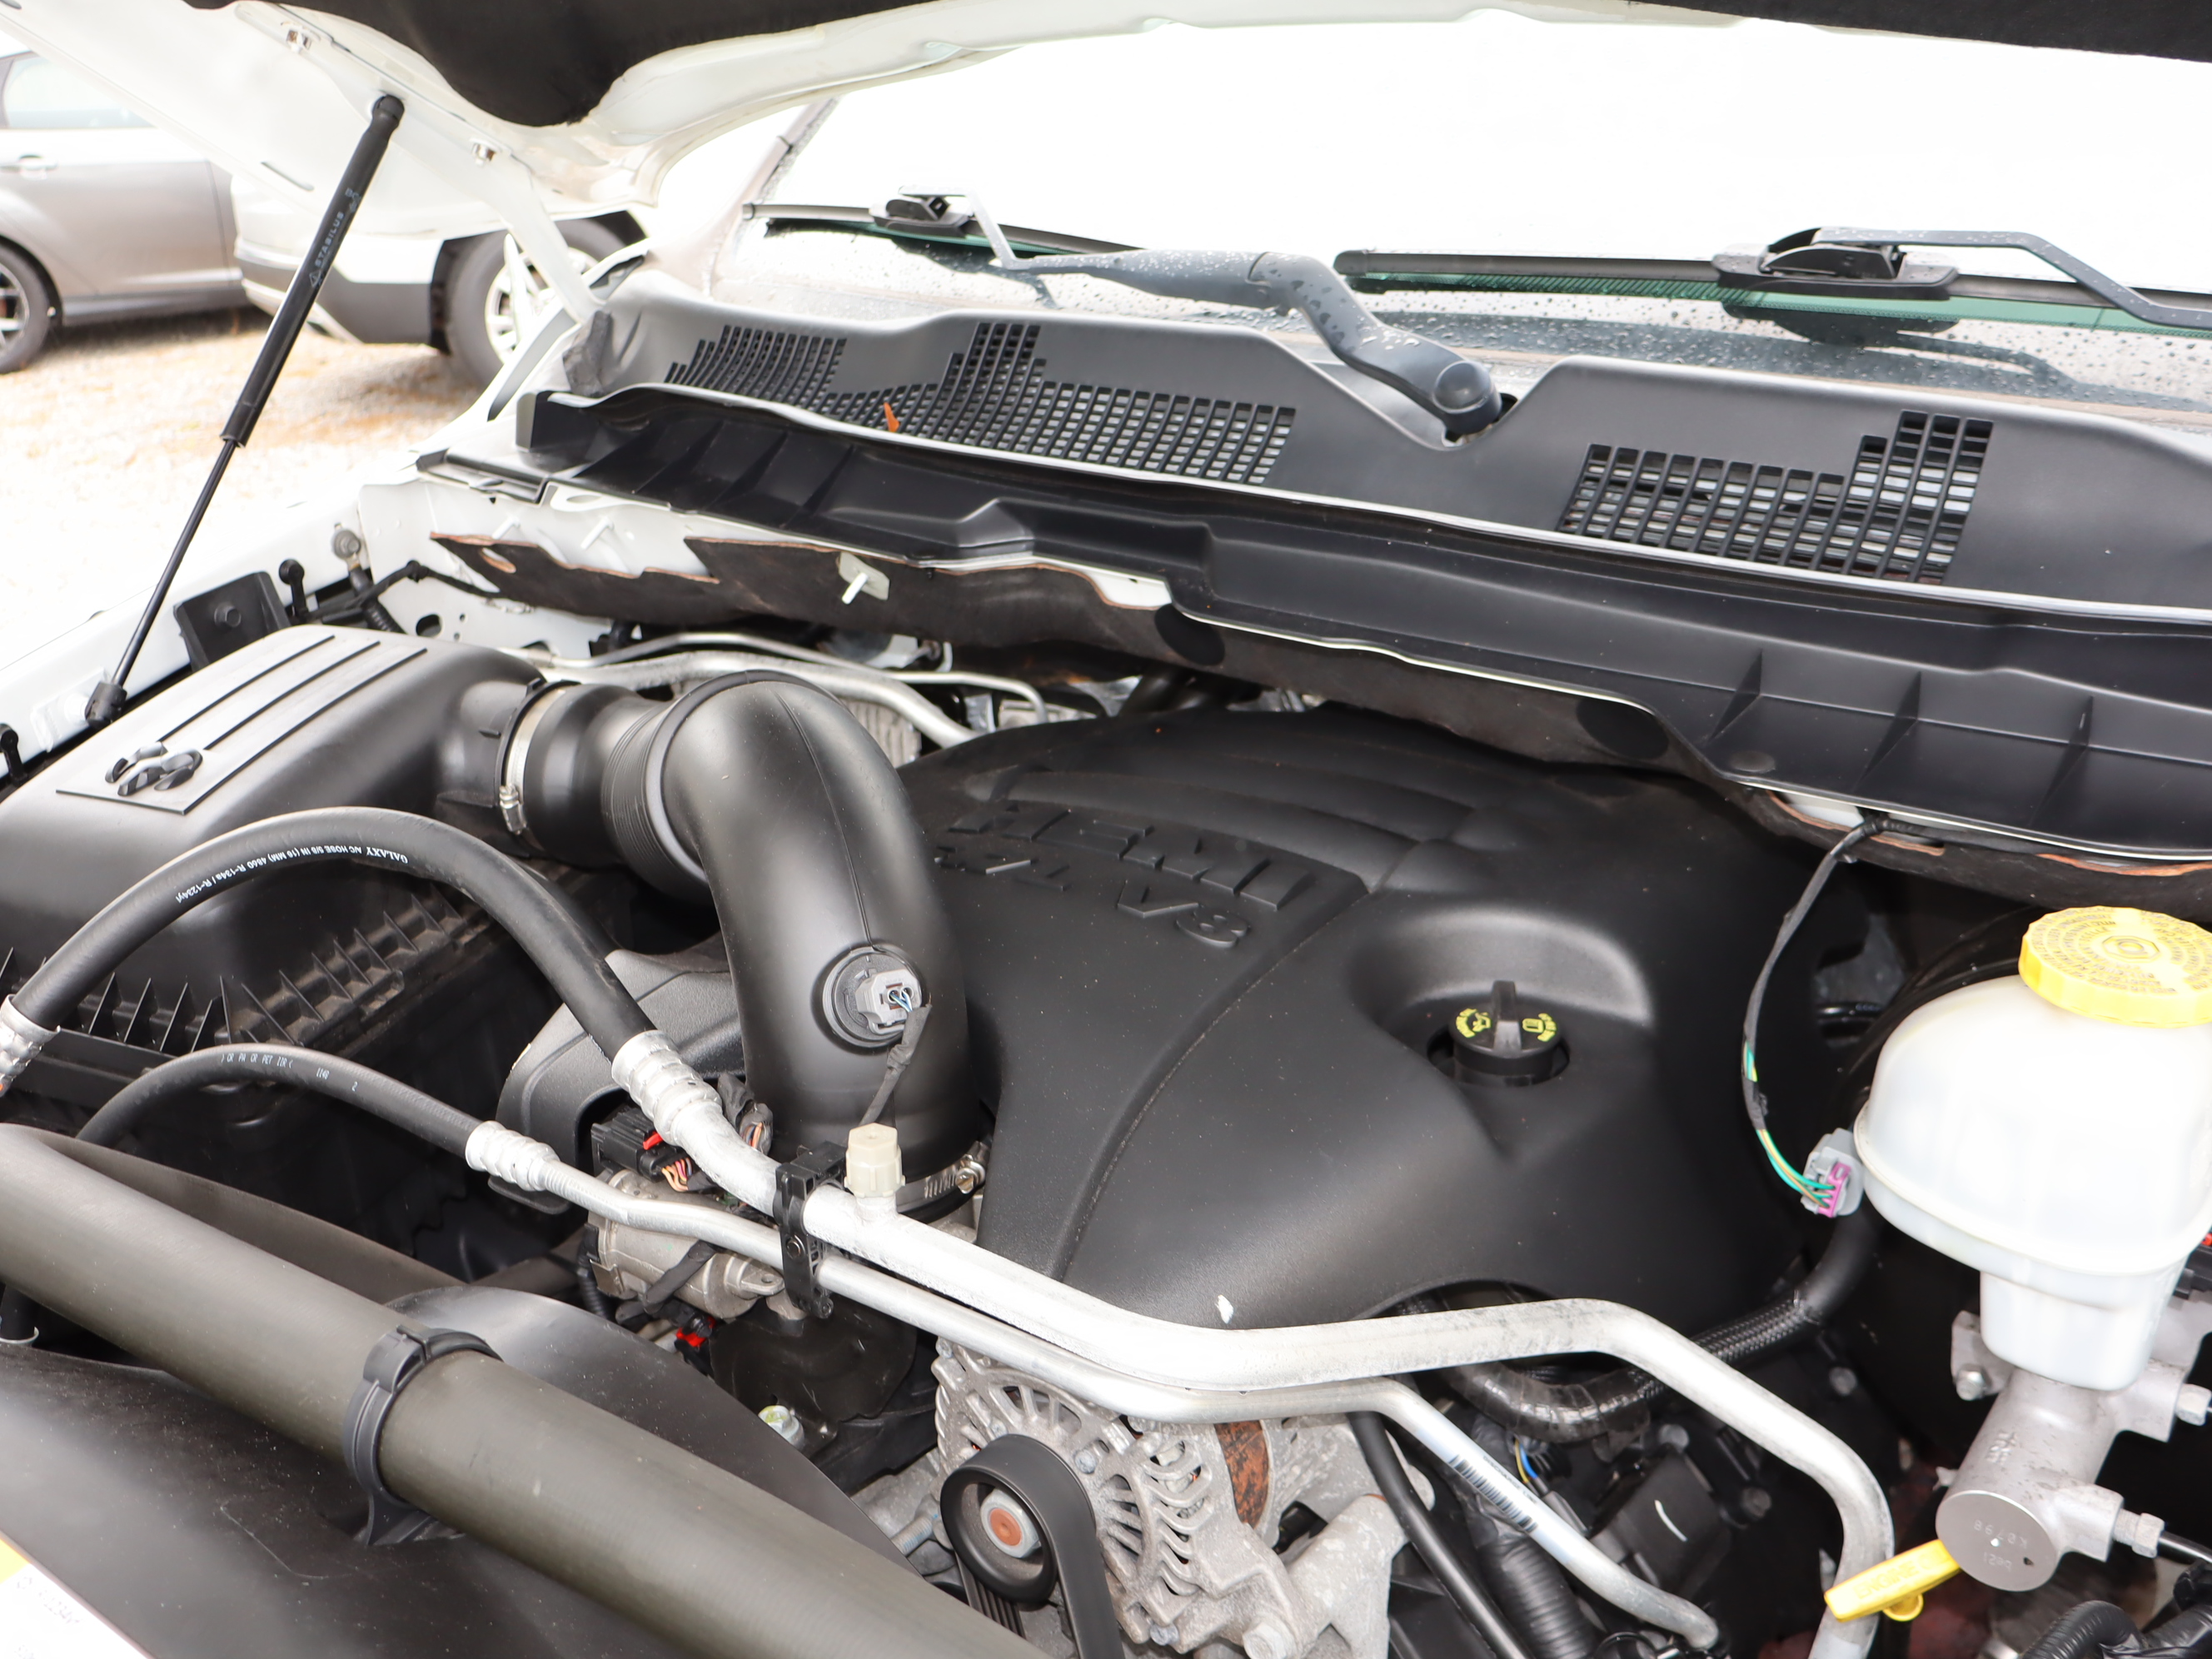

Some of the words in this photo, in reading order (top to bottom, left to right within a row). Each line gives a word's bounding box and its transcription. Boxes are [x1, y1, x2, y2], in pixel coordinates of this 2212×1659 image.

[300, 847, 311, 856] IN
[323, 844, 349, 854] HOSE
[348, 845, 362, 854] A/C
[366, 846, 408, 864] GALAXY
[947, 801, 1314, 911] HEMI
[1853, 1560, 1919, 1599] ENGINE
